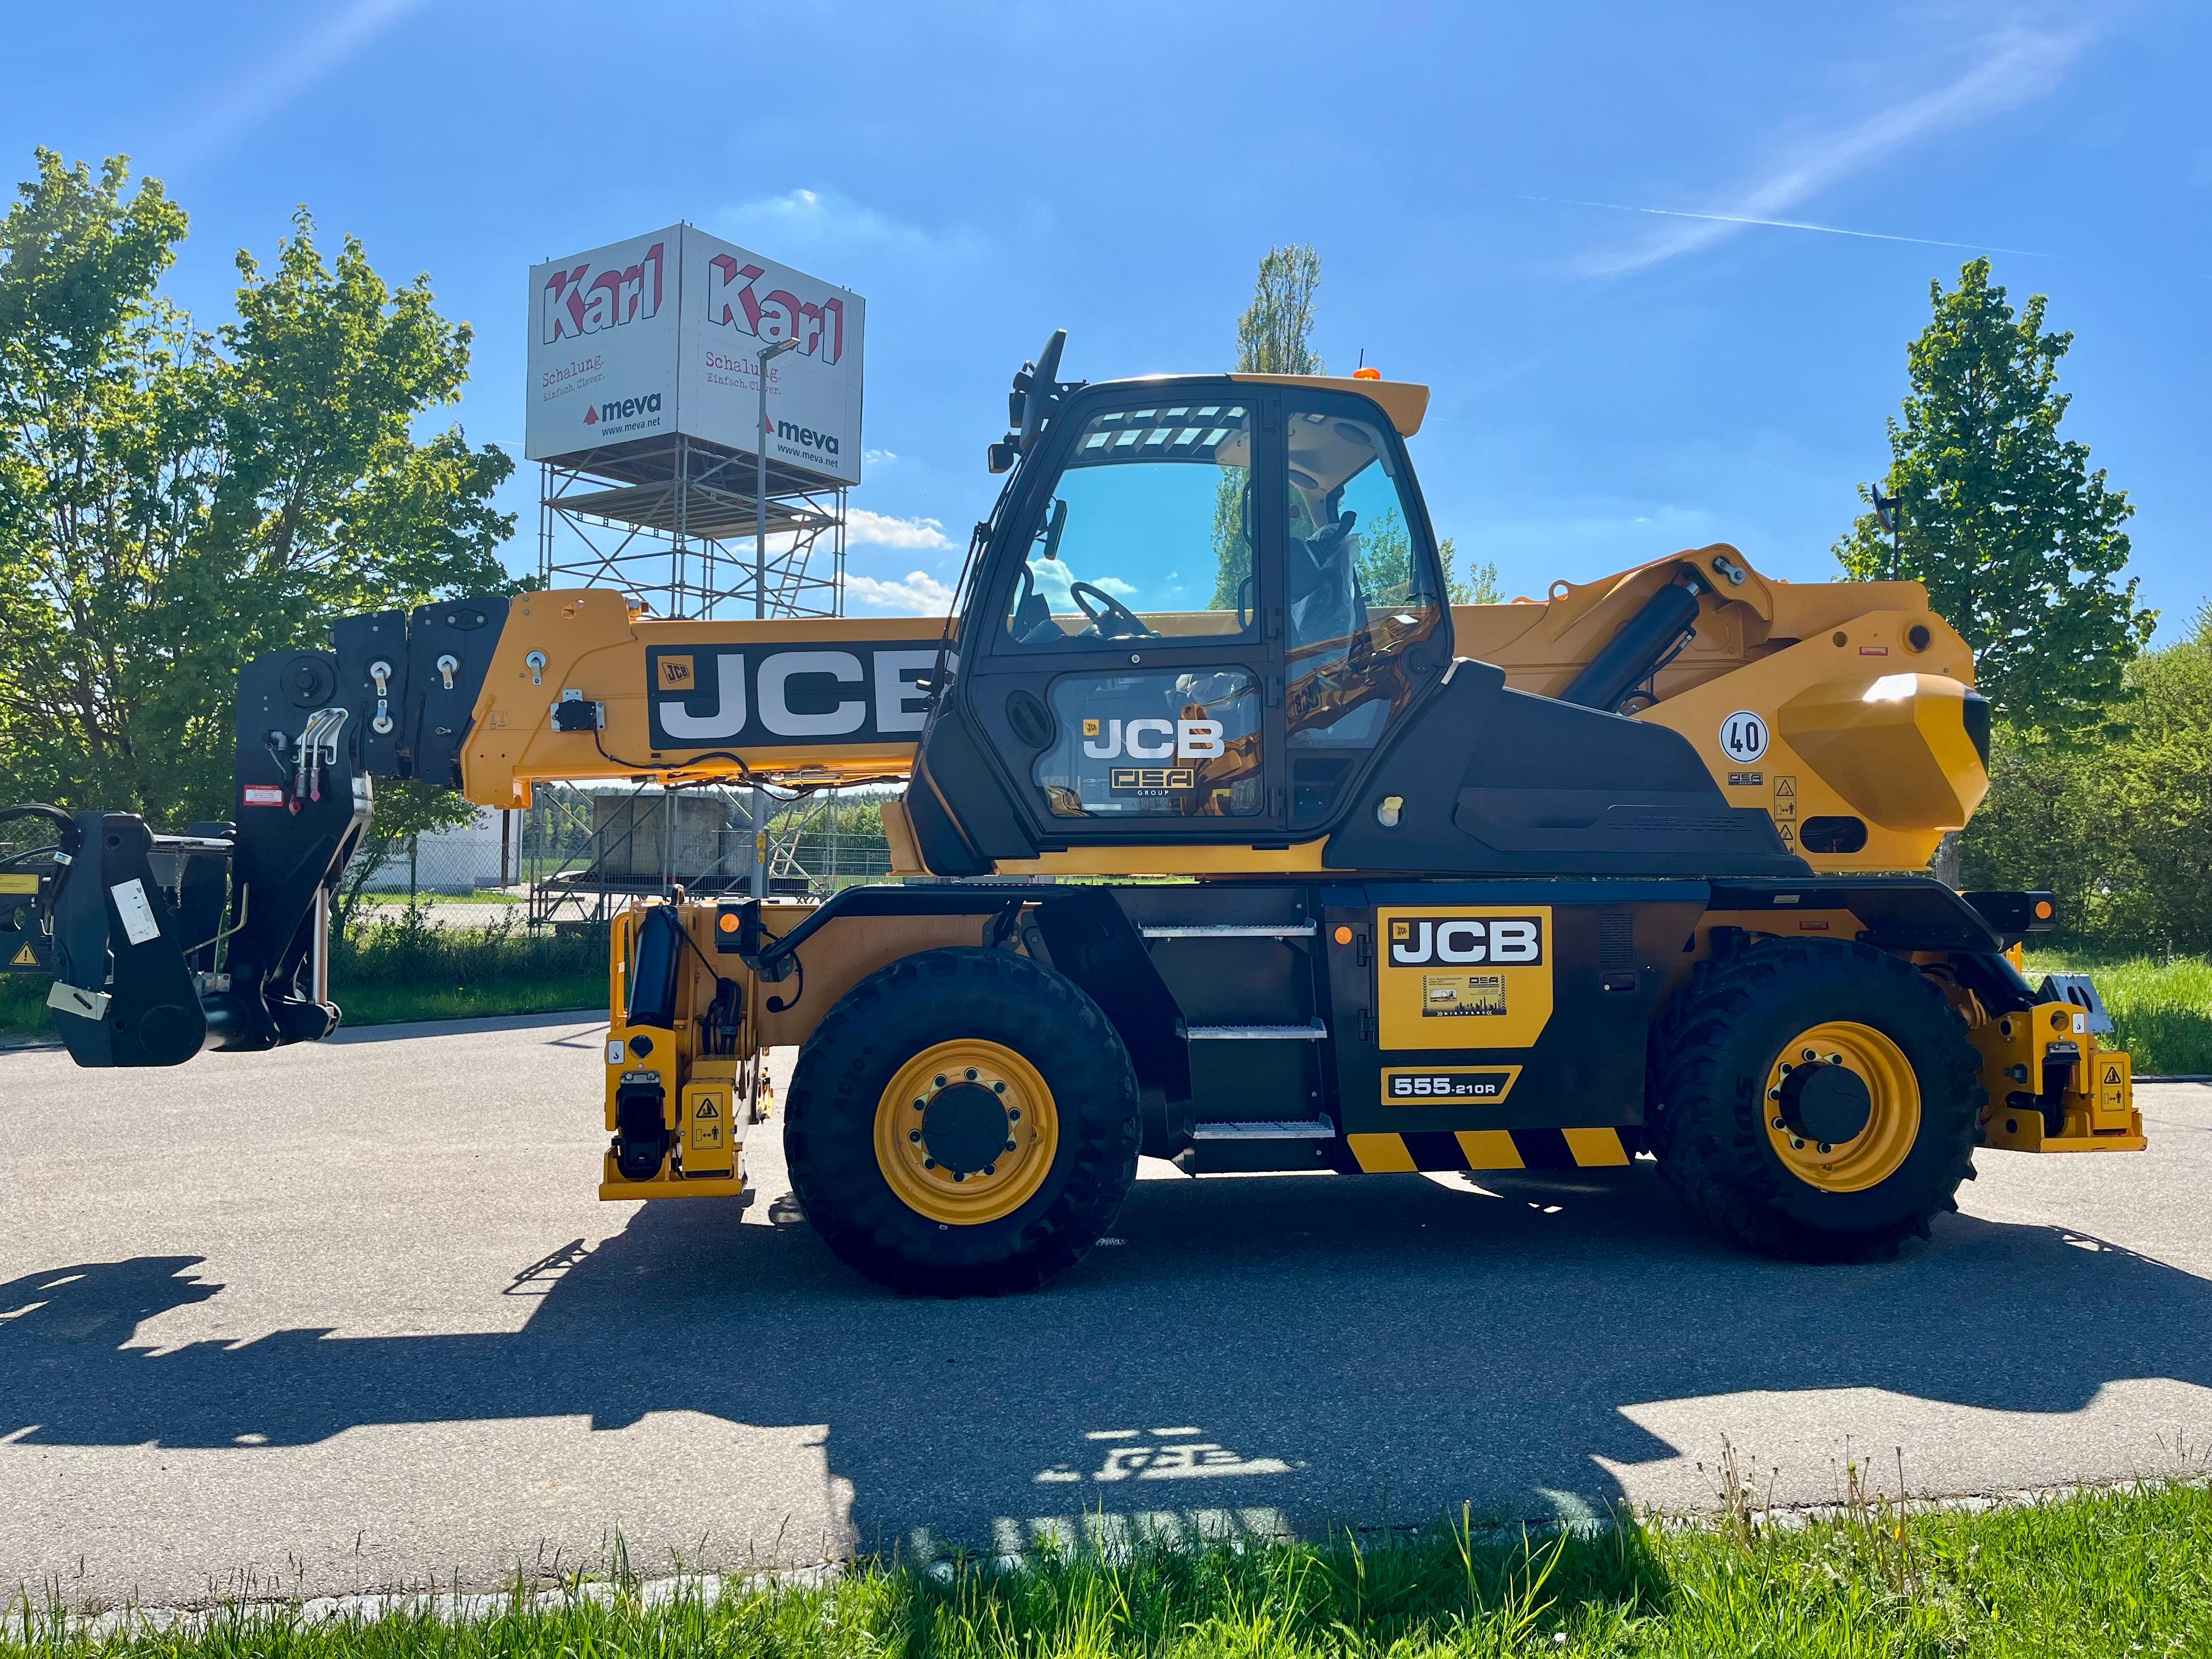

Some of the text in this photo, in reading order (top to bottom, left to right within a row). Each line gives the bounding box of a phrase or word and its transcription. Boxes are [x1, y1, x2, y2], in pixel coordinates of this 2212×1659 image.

[544, 243, 664, 345] Karl
[708, 253, 843, 365] Karl
[543, 355, 604, 387] Schalung.
[707, 373, 781, 394] Einfach. Cler.
[543, 374, 605, 402] Einfach. Clever.
[602, 393, 661, 422] meva
[602, 417, 661, 436] www.meva.net
[778, 420, 838, 455] meva
[777, 444, 838, 469] www.meva.net
[667, 664, 688, 681] JCB
[1083, 719, 1226, 759] JCB
[1730, 722, 1759, 753] 40
[1392, 921, 1539, 963] JCB
[1395, 1077, 1496, 1095] 555-210R
